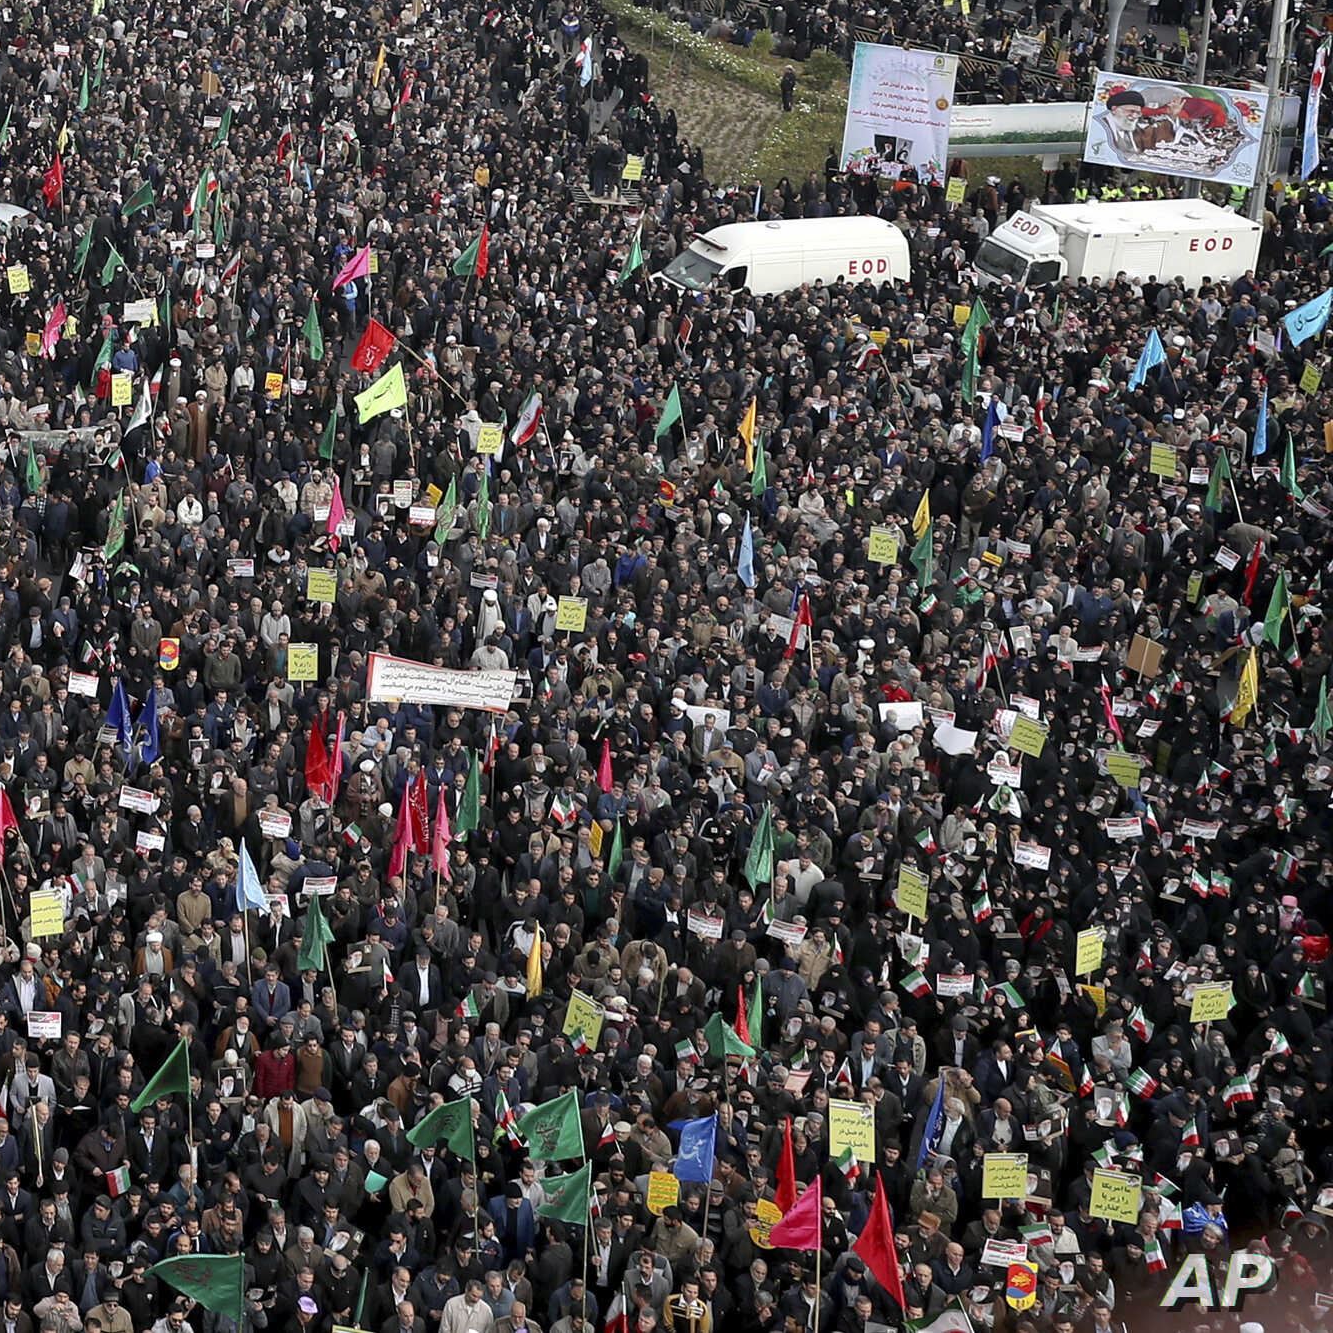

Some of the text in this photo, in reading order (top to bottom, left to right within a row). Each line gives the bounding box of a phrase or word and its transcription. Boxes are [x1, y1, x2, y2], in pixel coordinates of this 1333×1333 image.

[1012, 217, 1041, 236] EOD
[1189, 237, 1233, 252] EOD
[849, 259, 887, 275] EOD
